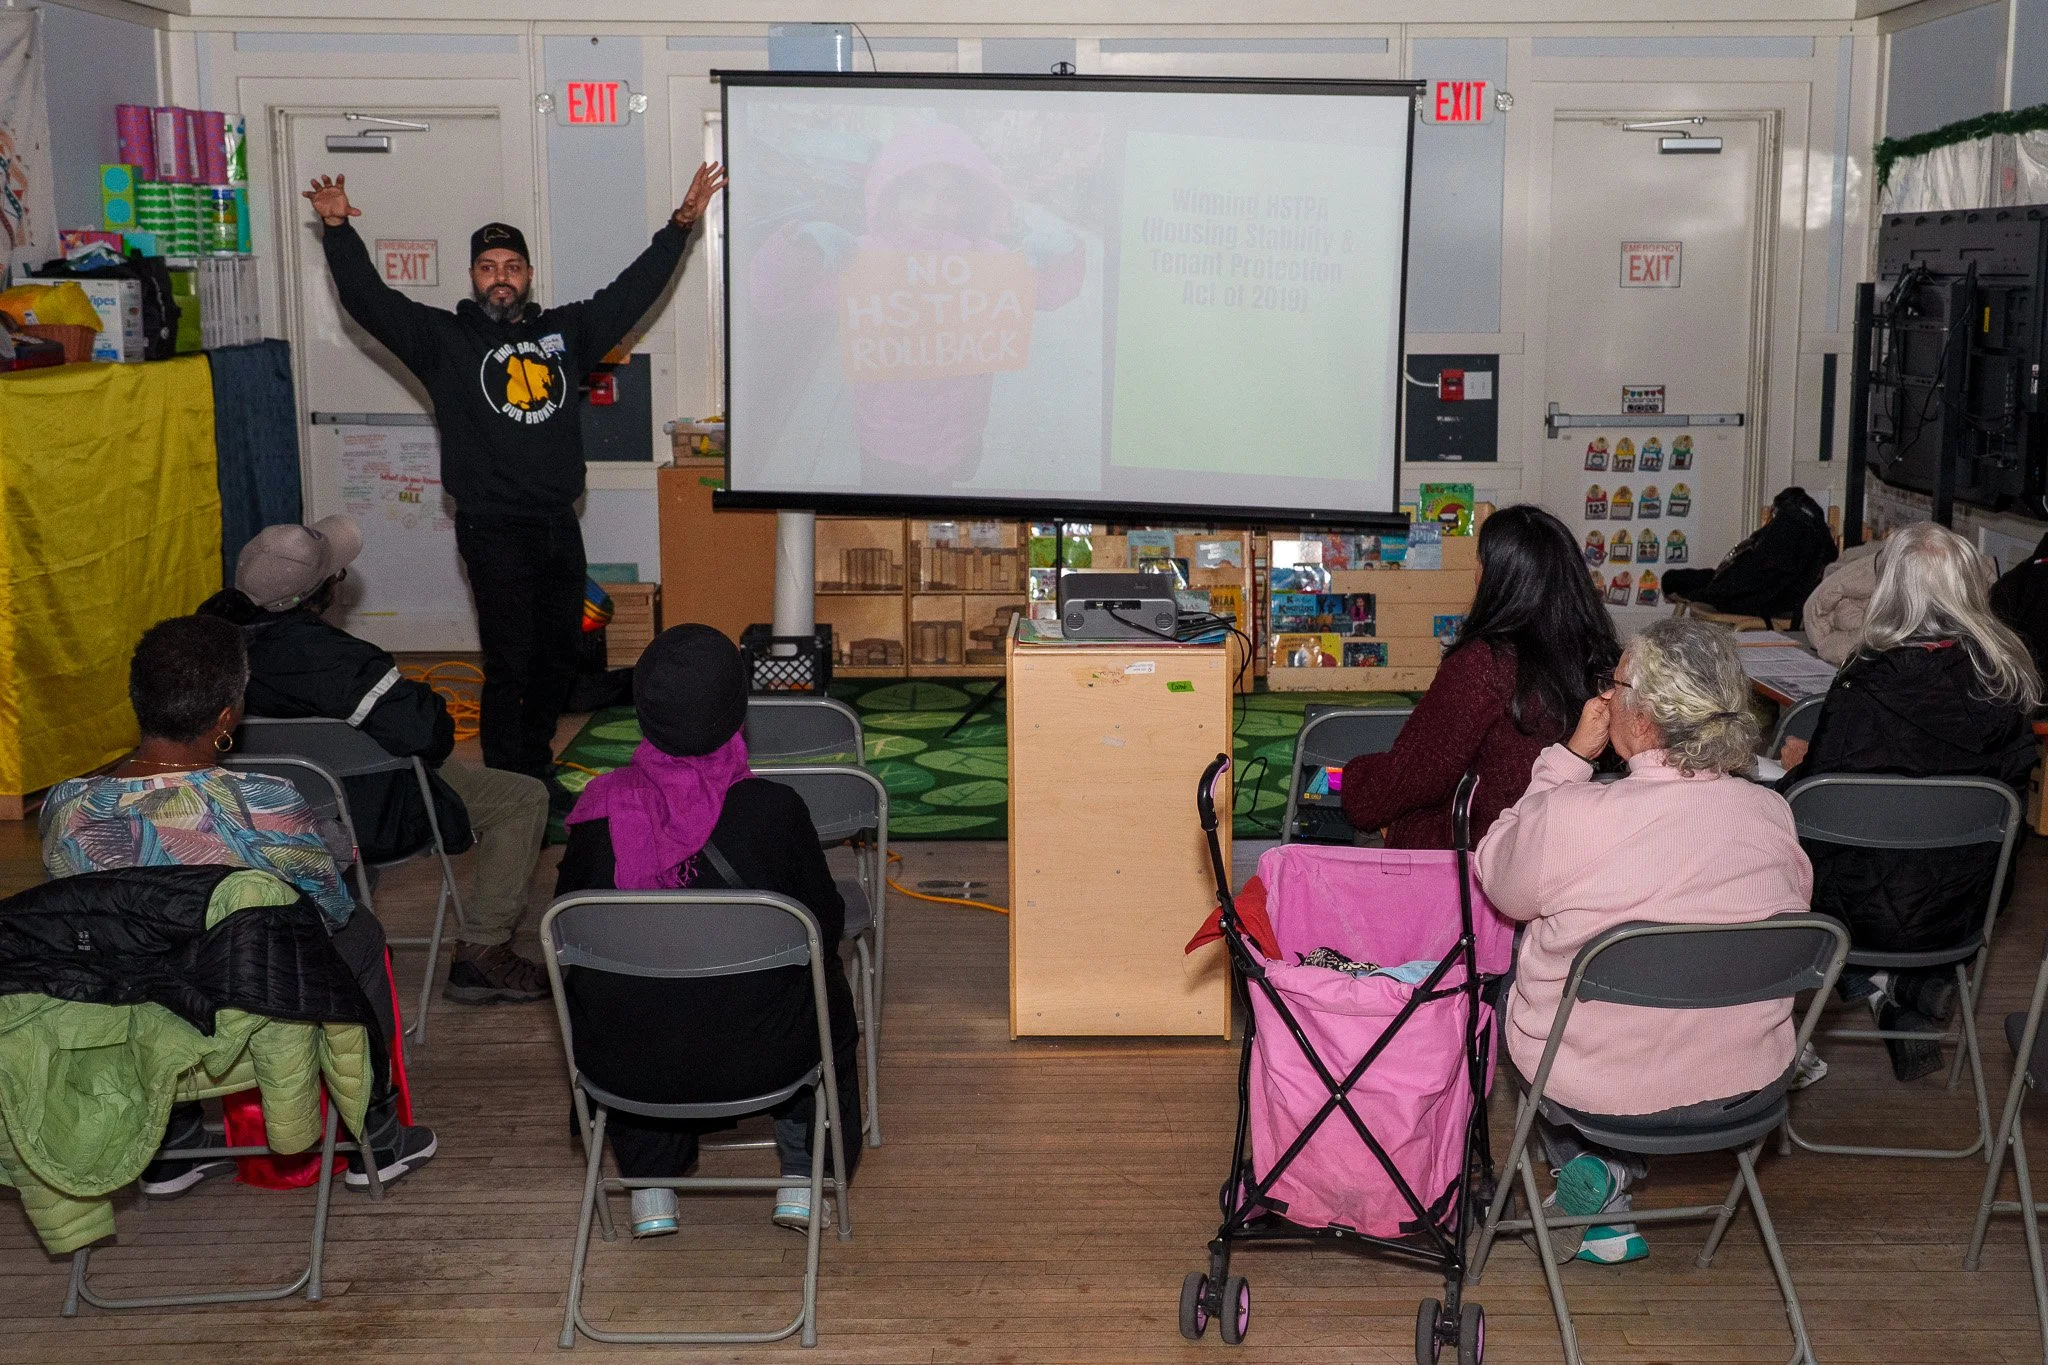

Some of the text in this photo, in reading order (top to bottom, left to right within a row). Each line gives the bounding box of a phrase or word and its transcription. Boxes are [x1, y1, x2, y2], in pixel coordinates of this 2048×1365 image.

[567, 83, 619, 124] EXIT
[1435, 81, 1487, 121] EXIT
[1171, 189, 1330, 222] Winning HSTPA
[1141, 216, 1238, 249] (Housing
[1245, 222, 1334, 256] Stability
[1623, 244, 1680, 252] EMERGENCY
[386, 253, 430, 280] EXIT
[906, 255, 972, 287] NO
[1150, 248, 1344, 284] Tenant Protection
[1629, 255, 1674, 281] EXIT
[846, 288, 1024, 330] HSTPA
[1182, 280, 1216, 306] Act
[1223, 284, 1245, 308] of
[850, 330, 1020, 371] ROLLBACK
[502, 402, 524, 422] OUR
[1588, 503, 1606, 514] 123
